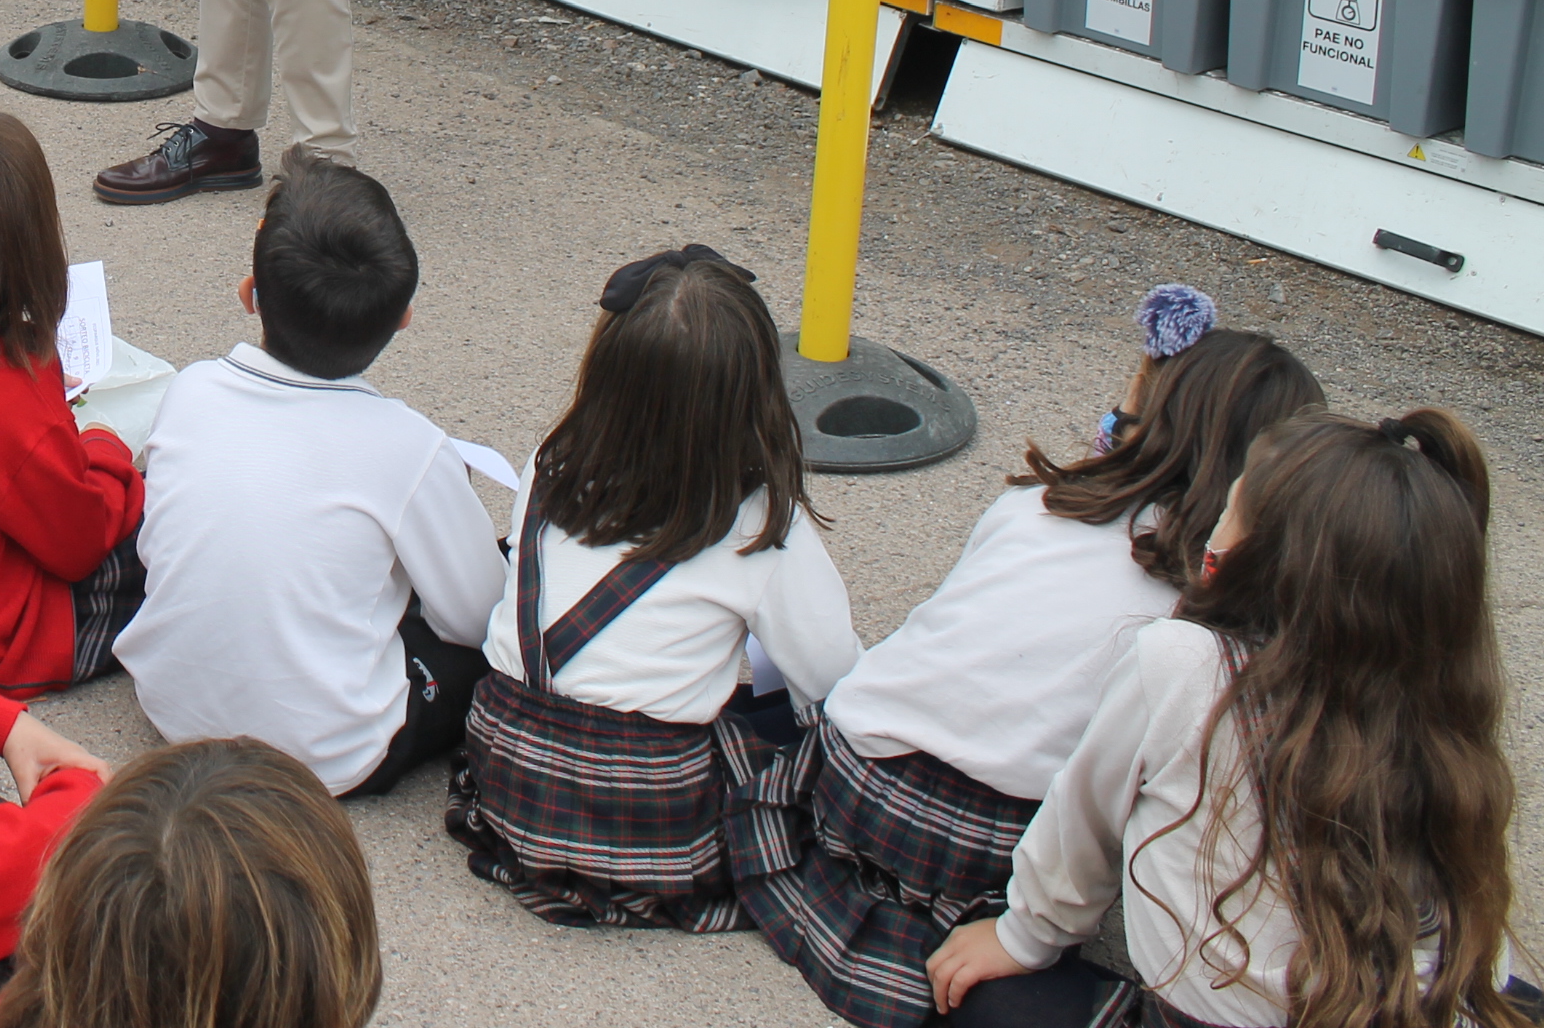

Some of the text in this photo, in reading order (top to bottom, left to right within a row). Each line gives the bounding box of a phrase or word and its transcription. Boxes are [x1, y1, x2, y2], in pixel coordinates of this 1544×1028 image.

[1315, 28, 1364, 50] PAE NO
[1302, 41, 1374, 69] FUNCIONAL
[79, 318, 88, 344] SORTEO
